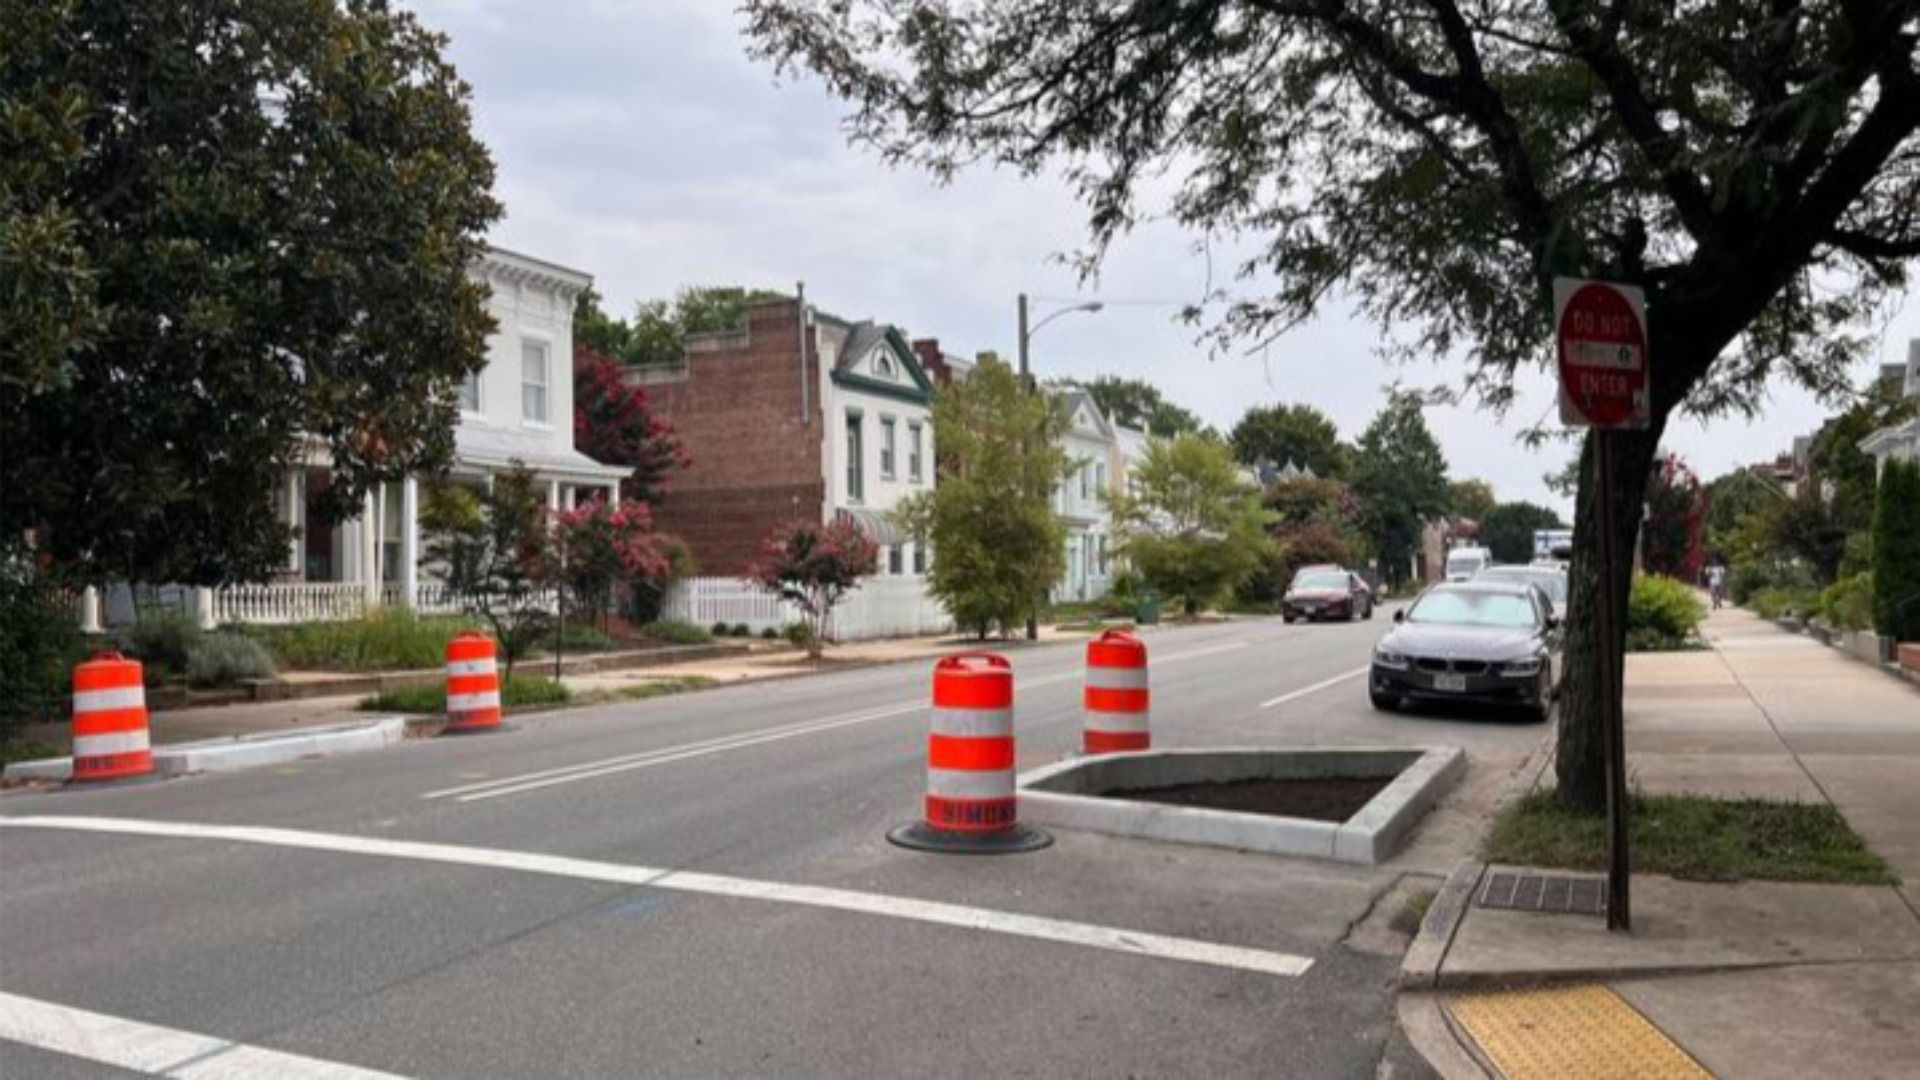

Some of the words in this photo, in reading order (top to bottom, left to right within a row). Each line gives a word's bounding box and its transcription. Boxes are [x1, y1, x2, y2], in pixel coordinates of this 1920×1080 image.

[1573, 311, 1595, 334] DO
[1601, 314, 1632, 337] NOT
[1579, 373, 1628, 396] ENTER
